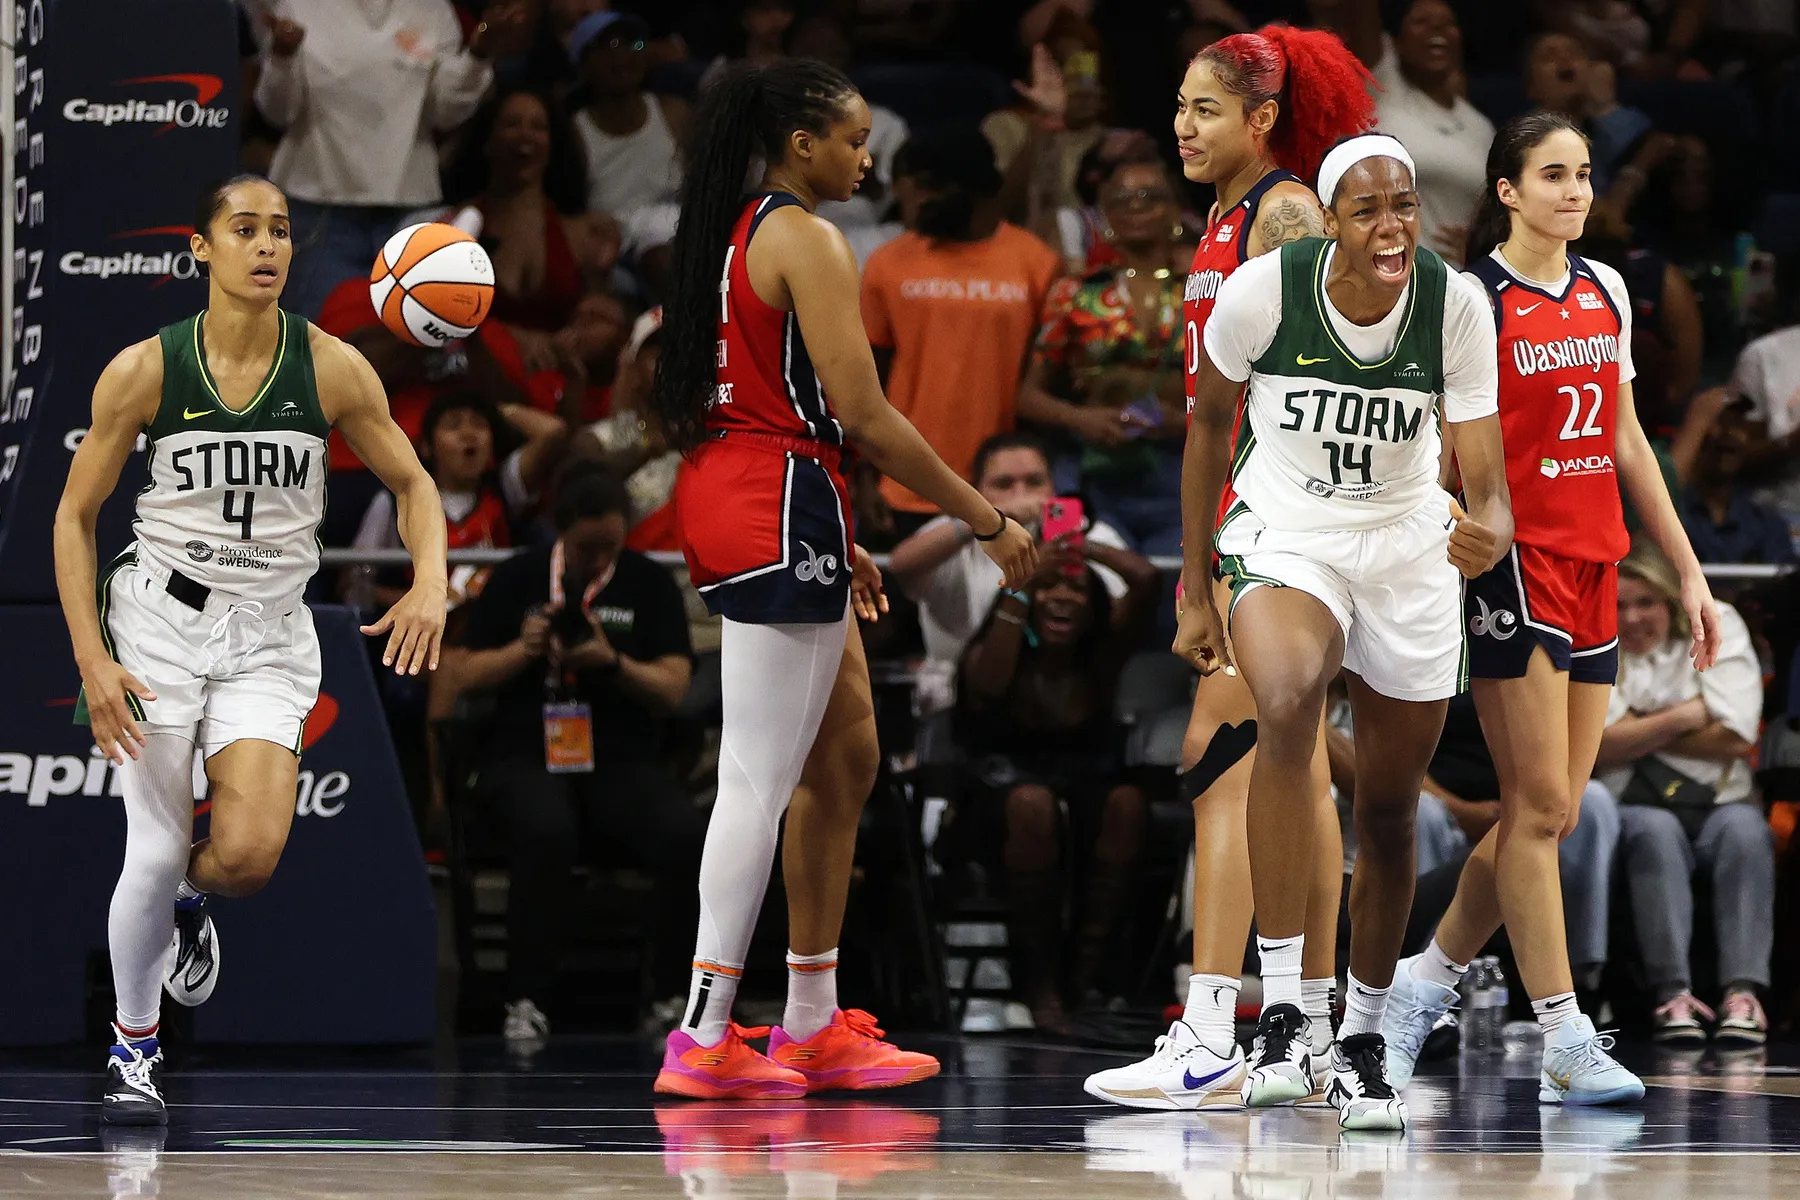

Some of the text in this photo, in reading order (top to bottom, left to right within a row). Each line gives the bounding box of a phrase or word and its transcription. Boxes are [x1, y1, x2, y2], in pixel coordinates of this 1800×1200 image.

[1575, 292, 1597, 302] CAR
[1513, 332, 1619, 377] Washington
[1280, 389, 1423, 443] STORM
[1557, 382, 1603, 441] 22
[172, 440, 311, 491] STORM
[1322, 441, 1373, 485] 14
[222, 490, 255, 540] 4
[217, 557, 270, 570] SWEDISH
[220, 544, 283, 559] Providence
